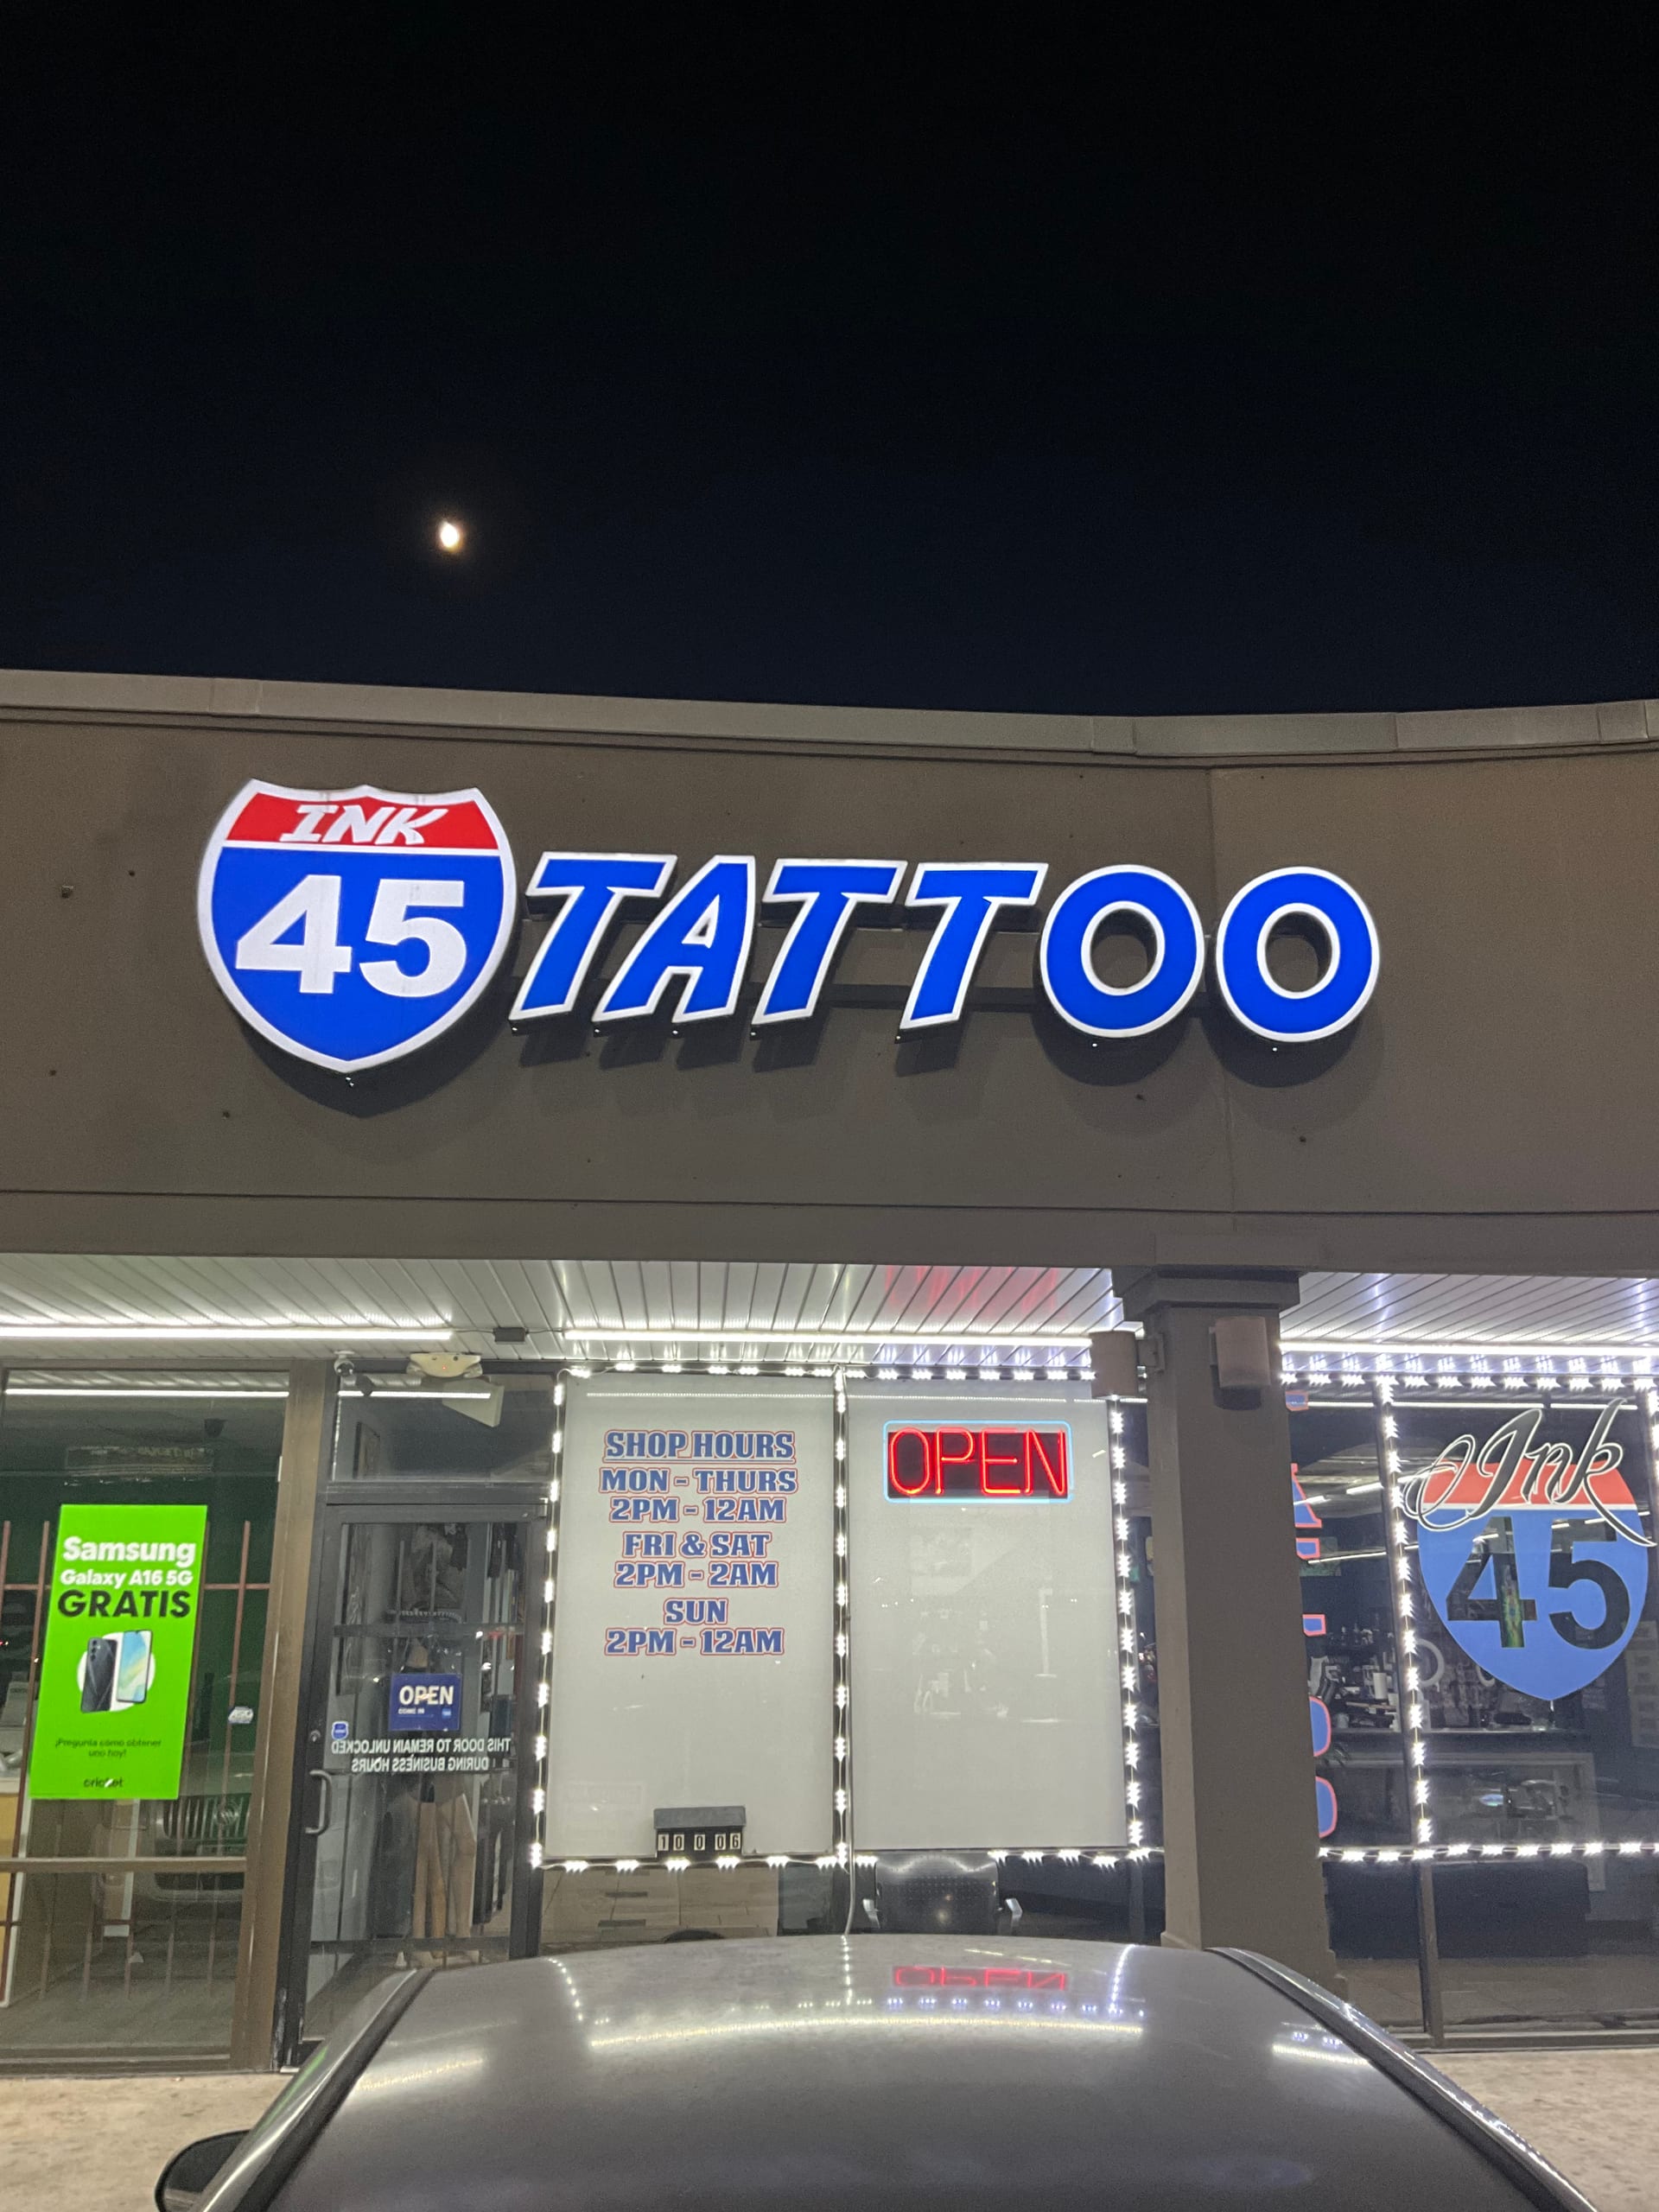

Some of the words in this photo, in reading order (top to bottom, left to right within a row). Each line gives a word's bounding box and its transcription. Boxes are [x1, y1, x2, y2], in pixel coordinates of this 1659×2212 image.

[278, 804, 448, 846] INK
[235, 874, 467, 997] 45
[509, 851, 1382, 1043] TATTOO
[606, 1430, 689, 1459] SHOP
[691, 1431, 795, 1460] HOURS
[888, 1427, 1066, 1496] OPEN
[1401, 1398, 1657, 1548] Ink
[599, 1467, 670, 1493] MON
[692, 1468, 798, 1495] THURS
[609, 1497, 680, 1522] 2PM
[702, 1497, 787, 1523] 12AM
[62, 1535, 196, 1568] Samsung
[622, 1531, 677, 1558] FRI
[678, 1531, 707, 1558] &
[709, 1531, 772, 1558] SAT
[60, 1569, 126, 1589] Galaxy
[129, 1570, 162, 1586] A16
[166, 1570, 194, 1586] 5G
[613, 1560, 685, 1588] 2PM
[708, 1560, 779, 1588] 2AM
[1446, 1516, 1630, 1649] 45
[58, 1589, 191, 1618] GRATIS
[664, 1598, 728, 1625] SUN
[604, 1627, 677, 1656] 2PM
[700, 1628, 785, 1656] 12AM
[399, 1685, 454, 1705] OPEN
